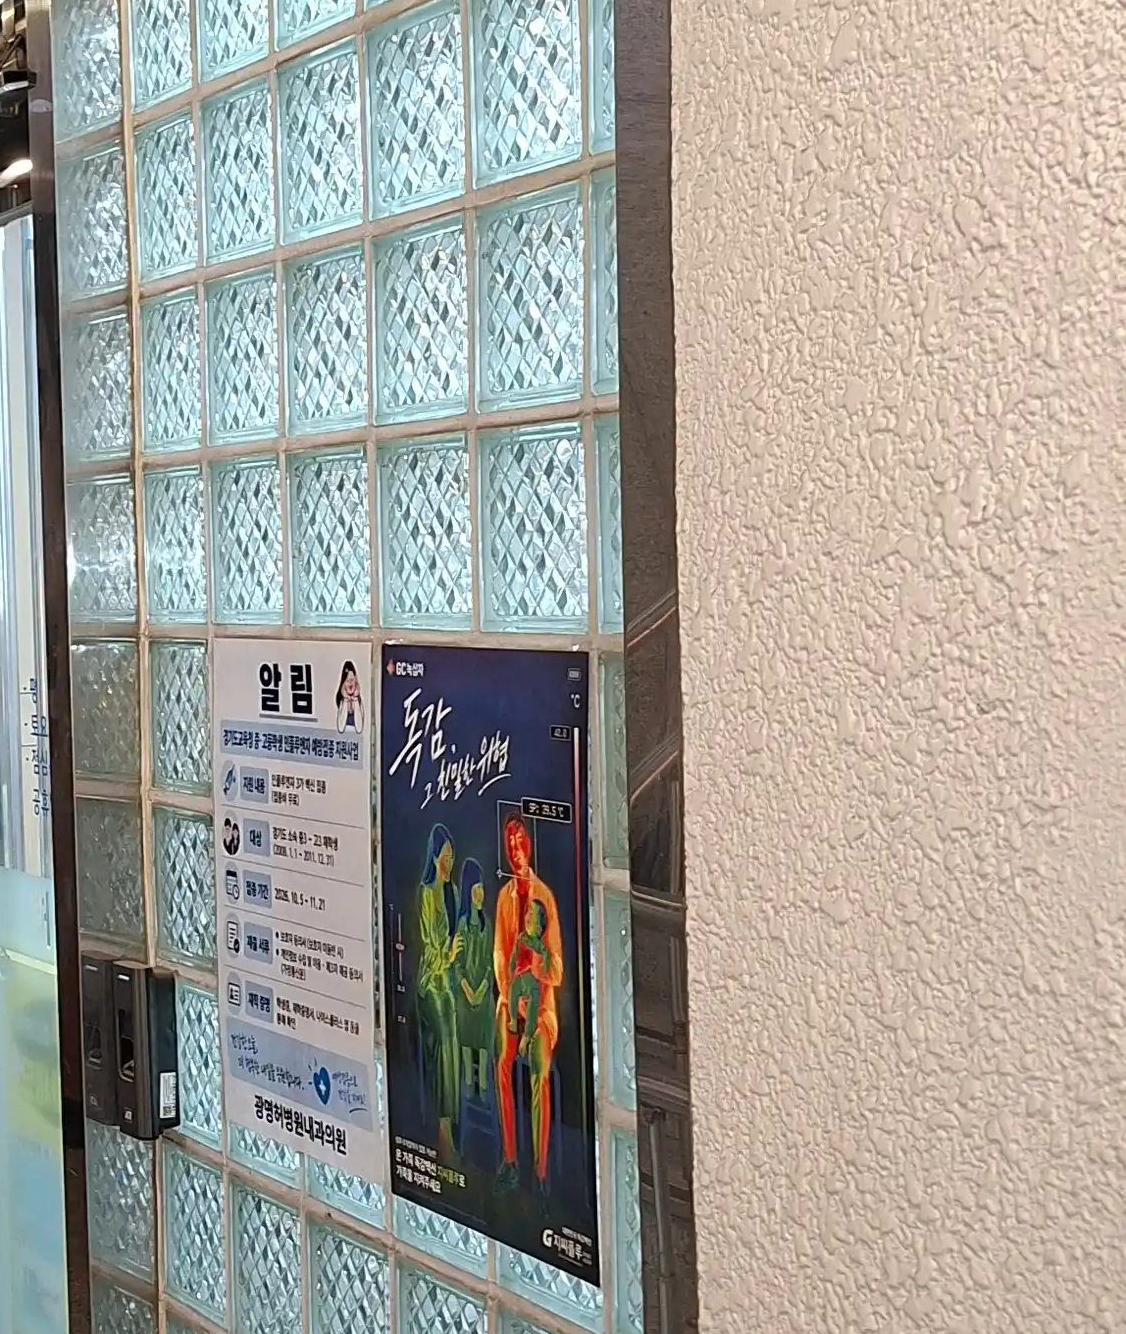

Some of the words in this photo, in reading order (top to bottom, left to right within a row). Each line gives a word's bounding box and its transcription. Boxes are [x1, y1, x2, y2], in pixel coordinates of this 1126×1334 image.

[395, 661, 424, 677] GC녹십자
[336, 741, 358, 760] 지원사업
[420, 782, 434, 810] 그
[436, 753, 476, 801] 친밀한
[476, 729, 510, 783] 위협
[243, 777, 253, 792] 지원
[255, 778, 265, 793] 내용
[250, 829, 261, 846] 대상
[246, 881, 256, 896] 접종
[257, 883, 268, 899] 기간
[259, 938, 270, 954] 서류
[260, 996, 270, 1012] 증명
[254, 1094, 348, 1156] 광명허병원내과의원
